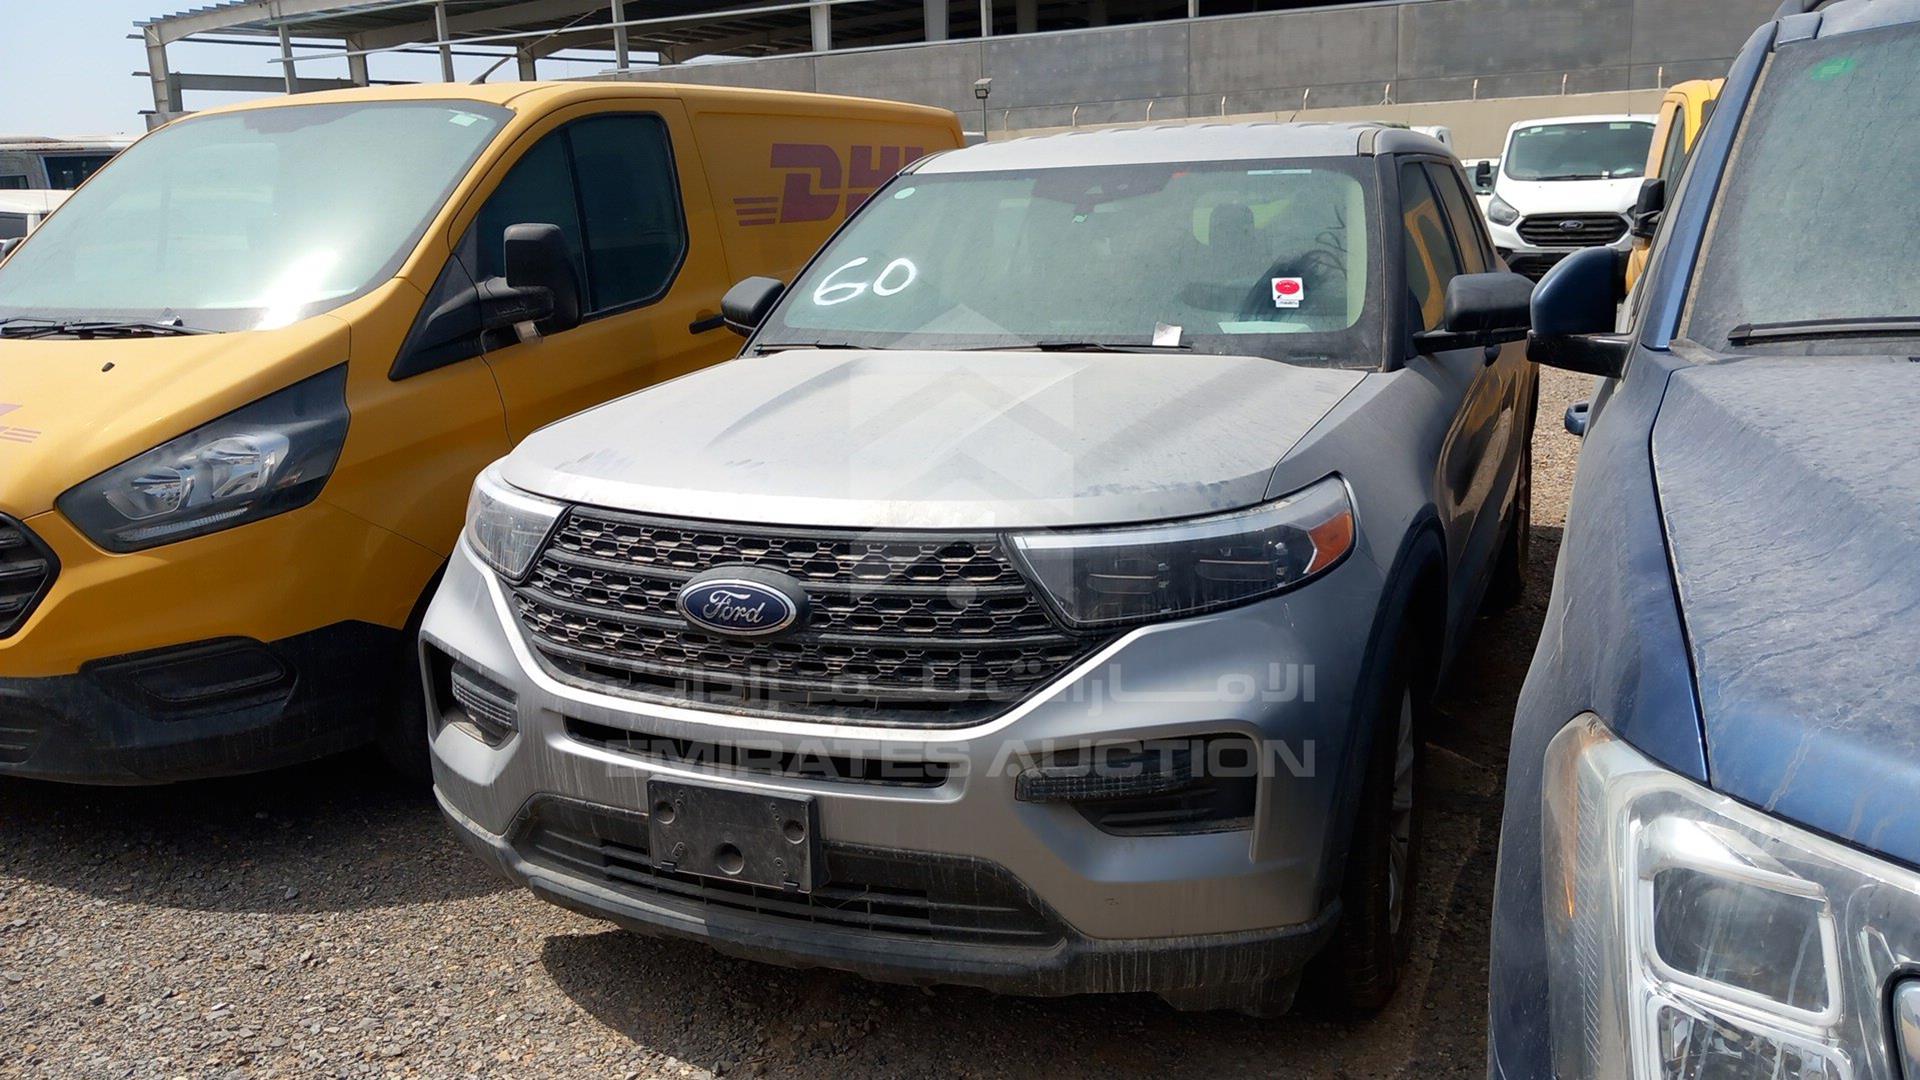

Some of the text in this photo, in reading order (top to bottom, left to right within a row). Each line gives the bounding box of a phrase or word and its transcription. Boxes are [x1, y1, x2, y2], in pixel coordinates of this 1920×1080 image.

[771, 143, 924, 223] DH
[813, 257, 917, 306] 60
[703, 590, 766, 624] Ford
